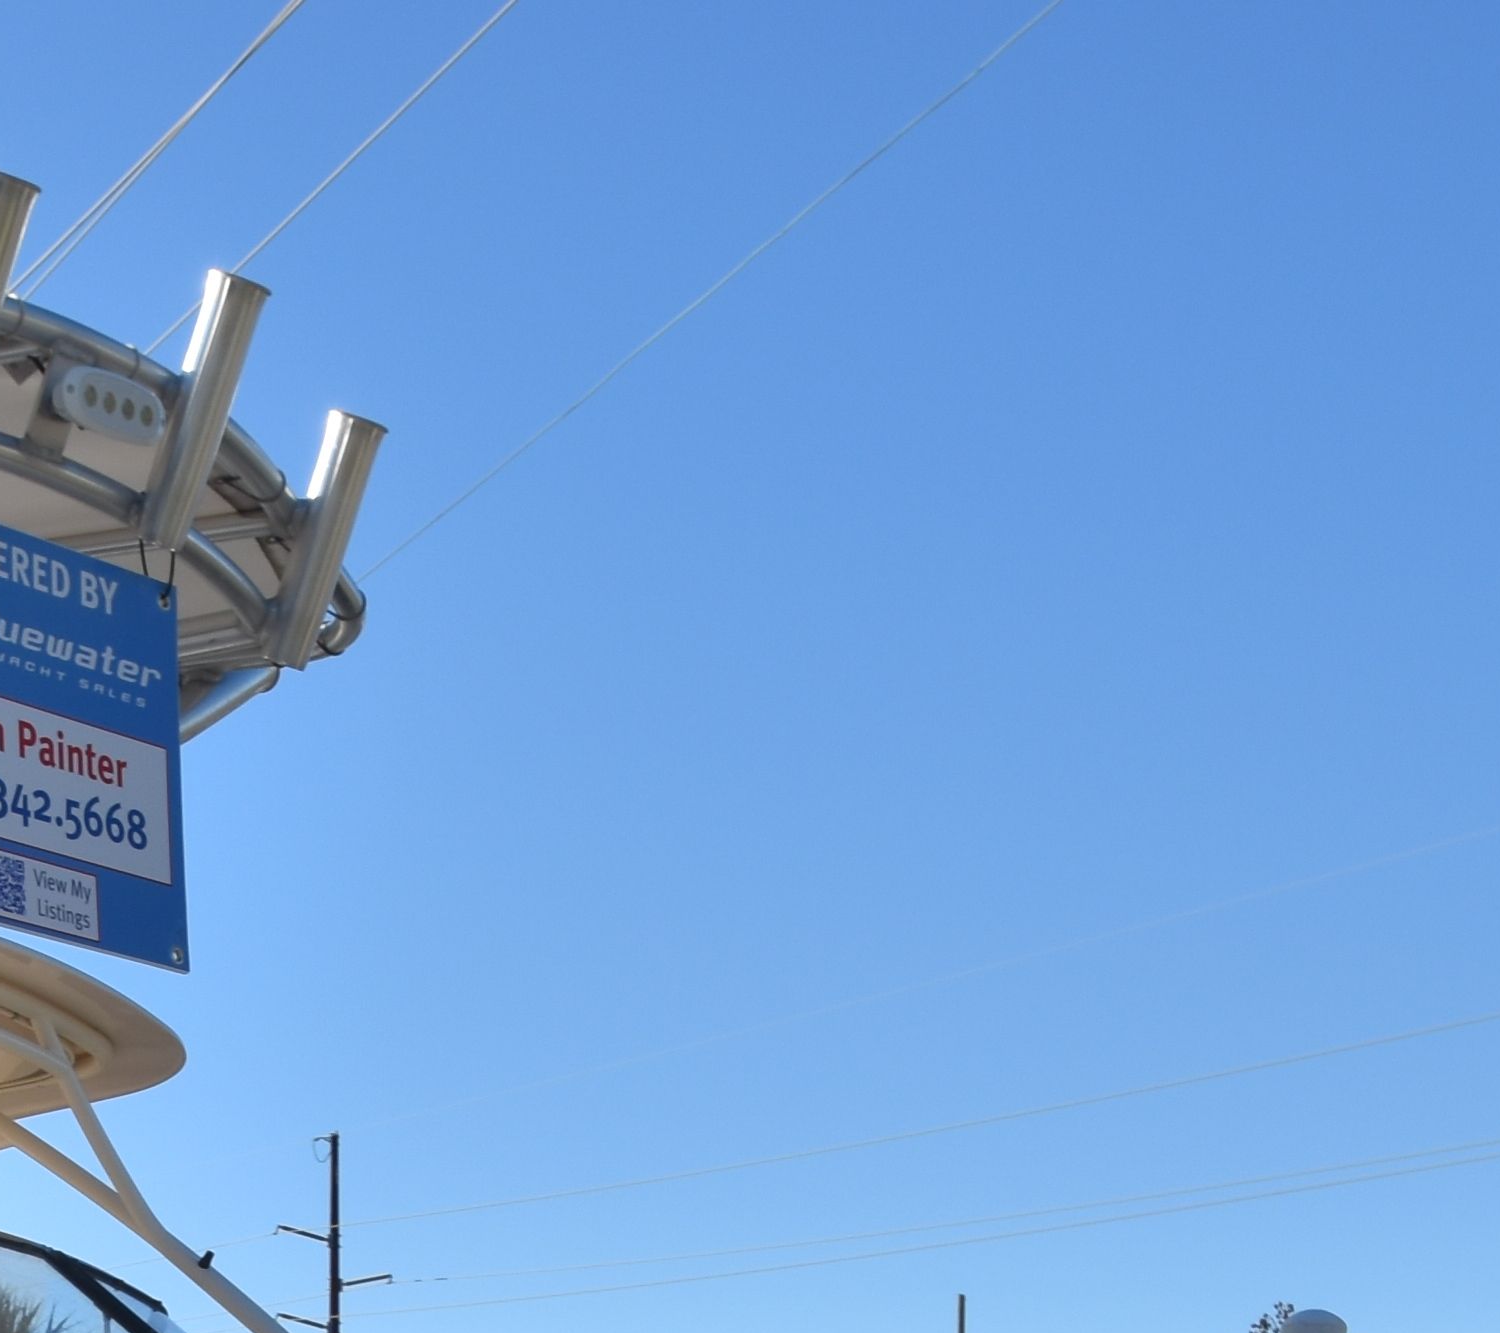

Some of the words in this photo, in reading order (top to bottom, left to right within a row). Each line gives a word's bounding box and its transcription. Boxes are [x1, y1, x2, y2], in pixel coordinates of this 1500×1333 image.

[80, 570, 118, 615] BY
[79, 678, 147, 708] SALES
[18, 719, 128, 788] Painter
[33, 868, 67, 894] View
[71, 879, 92, 904] My
[37, 898, 91, 931] Listings
